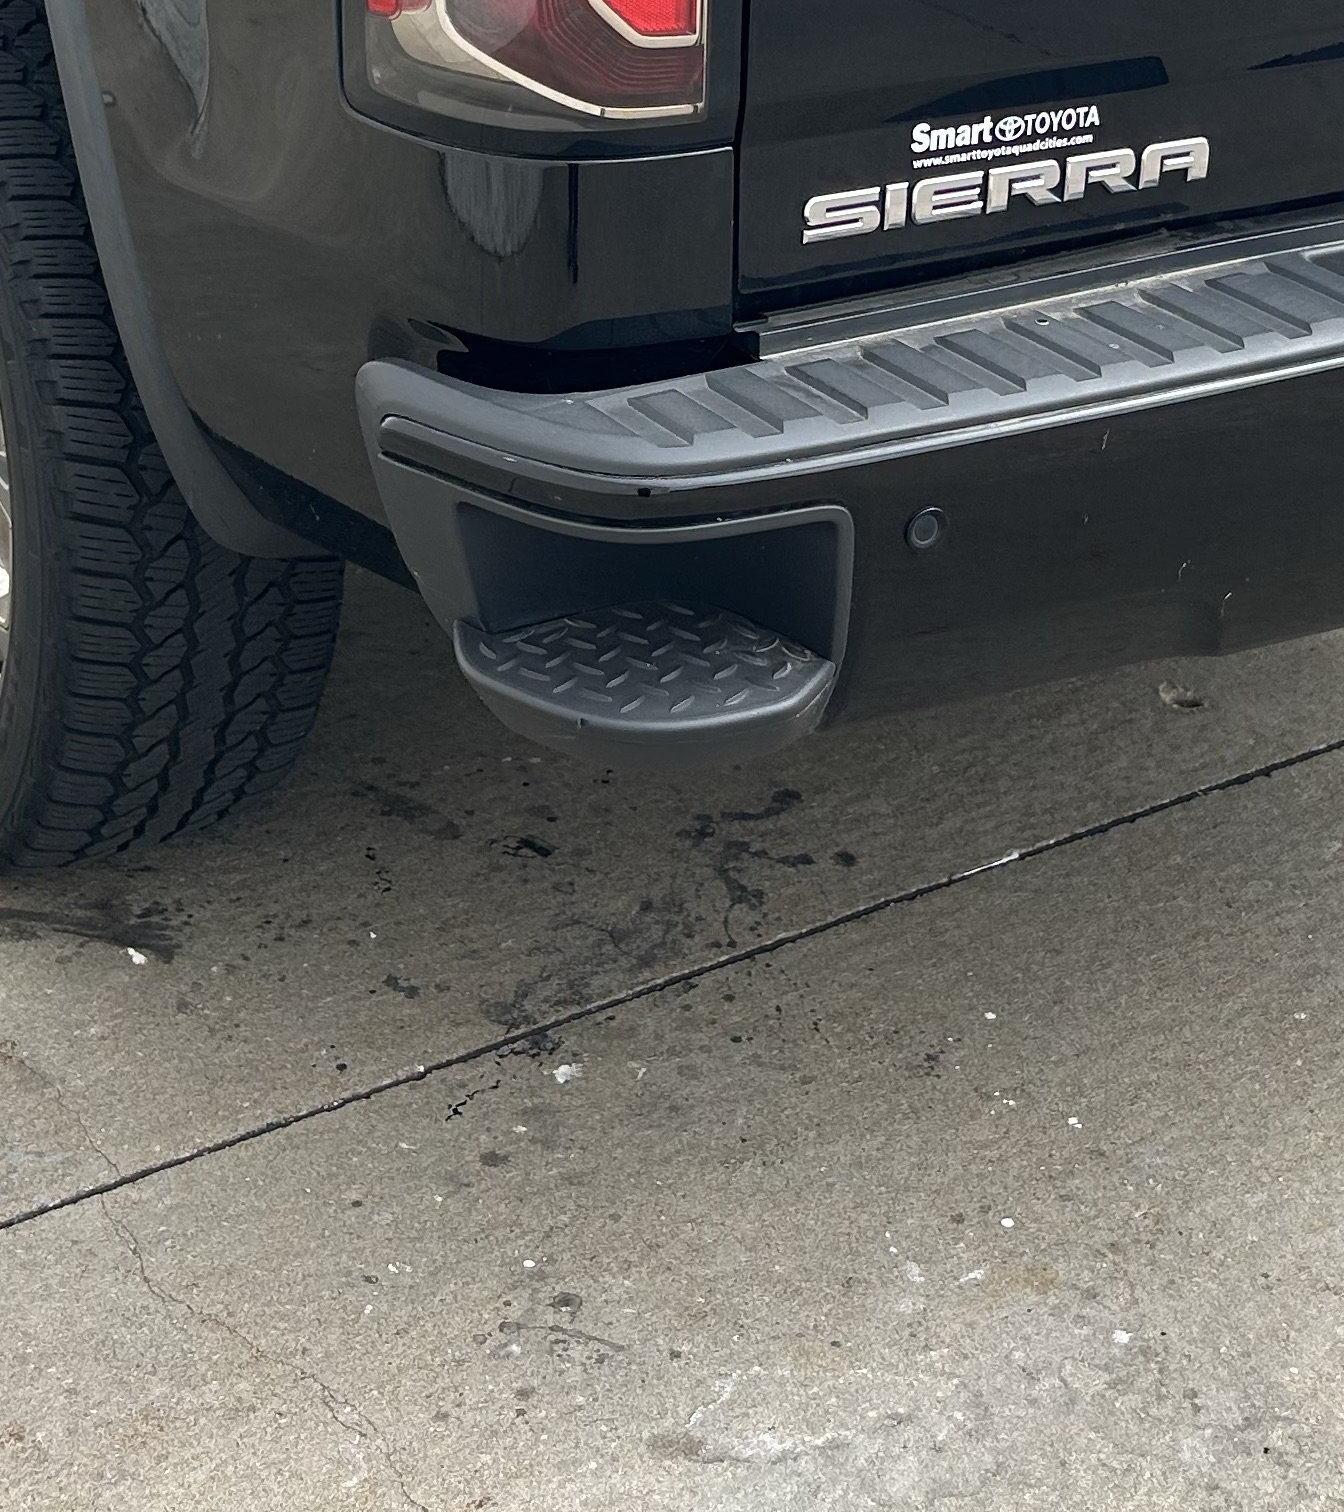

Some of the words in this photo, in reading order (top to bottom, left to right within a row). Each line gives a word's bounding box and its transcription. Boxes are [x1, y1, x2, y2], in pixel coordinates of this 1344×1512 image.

[910, 115, 994, 154] Smart
[1023, 105, 1101, 136] TOYOTA
[912, 134, 1094, 169] www.smarttoyotaquadcities.com
[801, 136, 1211, 245] SIERRA
